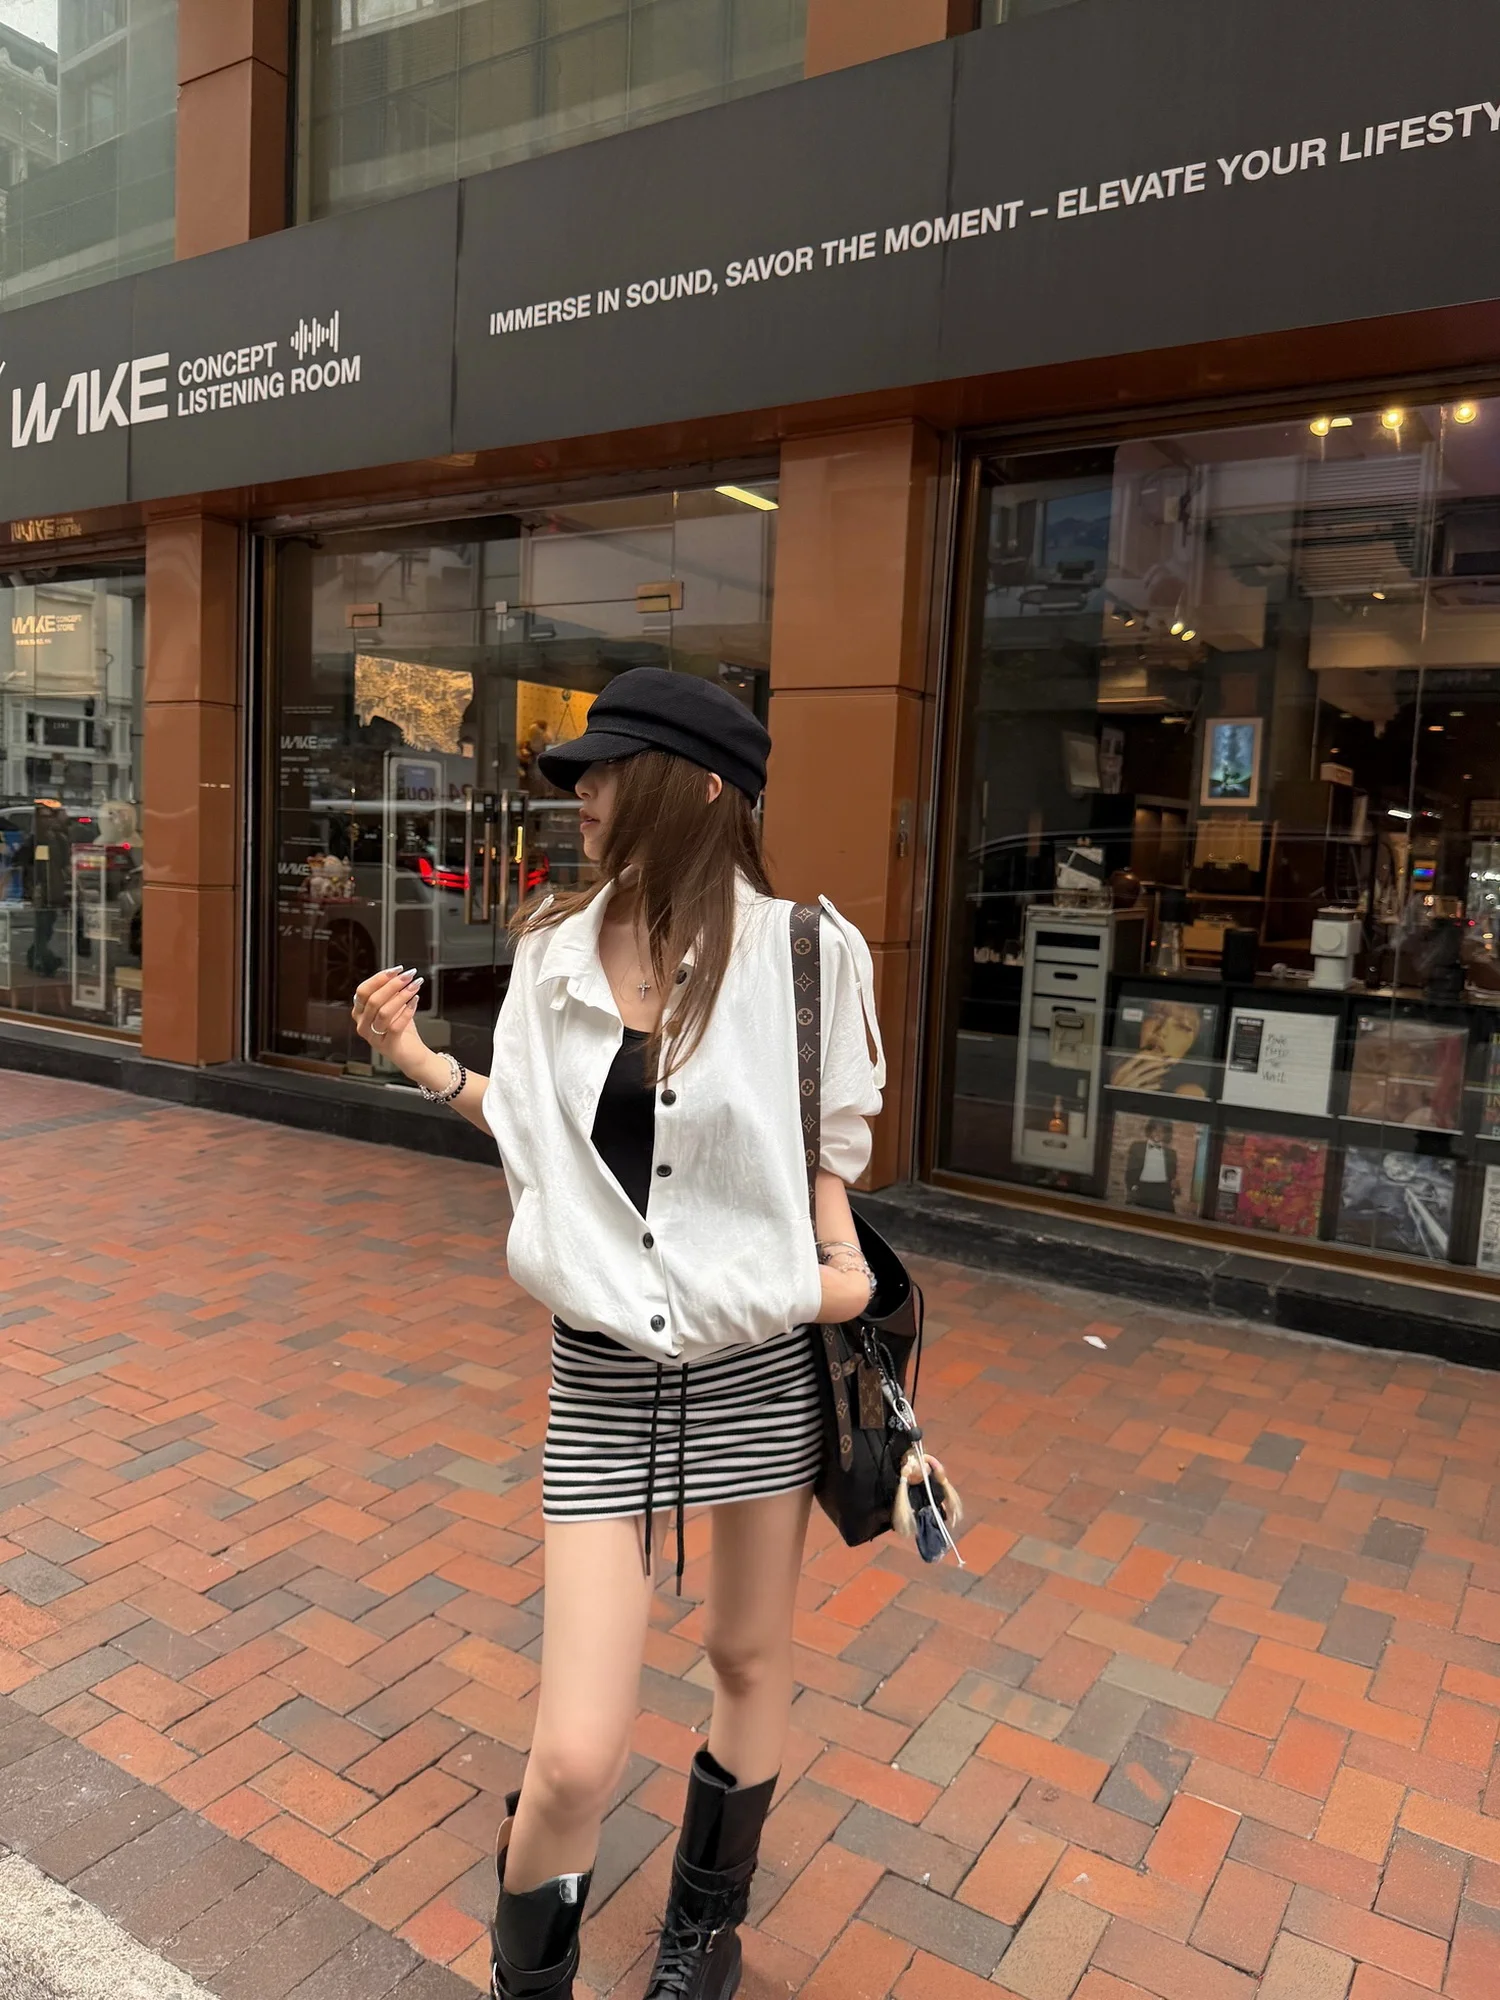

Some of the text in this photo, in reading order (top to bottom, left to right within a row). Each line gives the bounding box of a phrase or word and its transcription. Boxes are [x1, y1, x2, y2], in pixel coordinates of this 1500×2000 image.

[490, 294, 592, 335] IMMERSE
[598, 288, 620, 313] IN
[626, 269, 719, 307] SOUND,
[726, 247, 814, 286] SAVOR
[821, 232, 877, 266] THE
[885, 200, 1024, 254] MOMENT
[1058, 162, 1207, 218] ELEVATE
[1217, 138, 1327, 185] YOUR
[1340, 101, 1500, 161] LIFESTY
[12, 352, 170, 449] WAKE
[178, 342, 277, 387] CONCEPT
[178, 354, 361, 416] LISTENING ROOM
